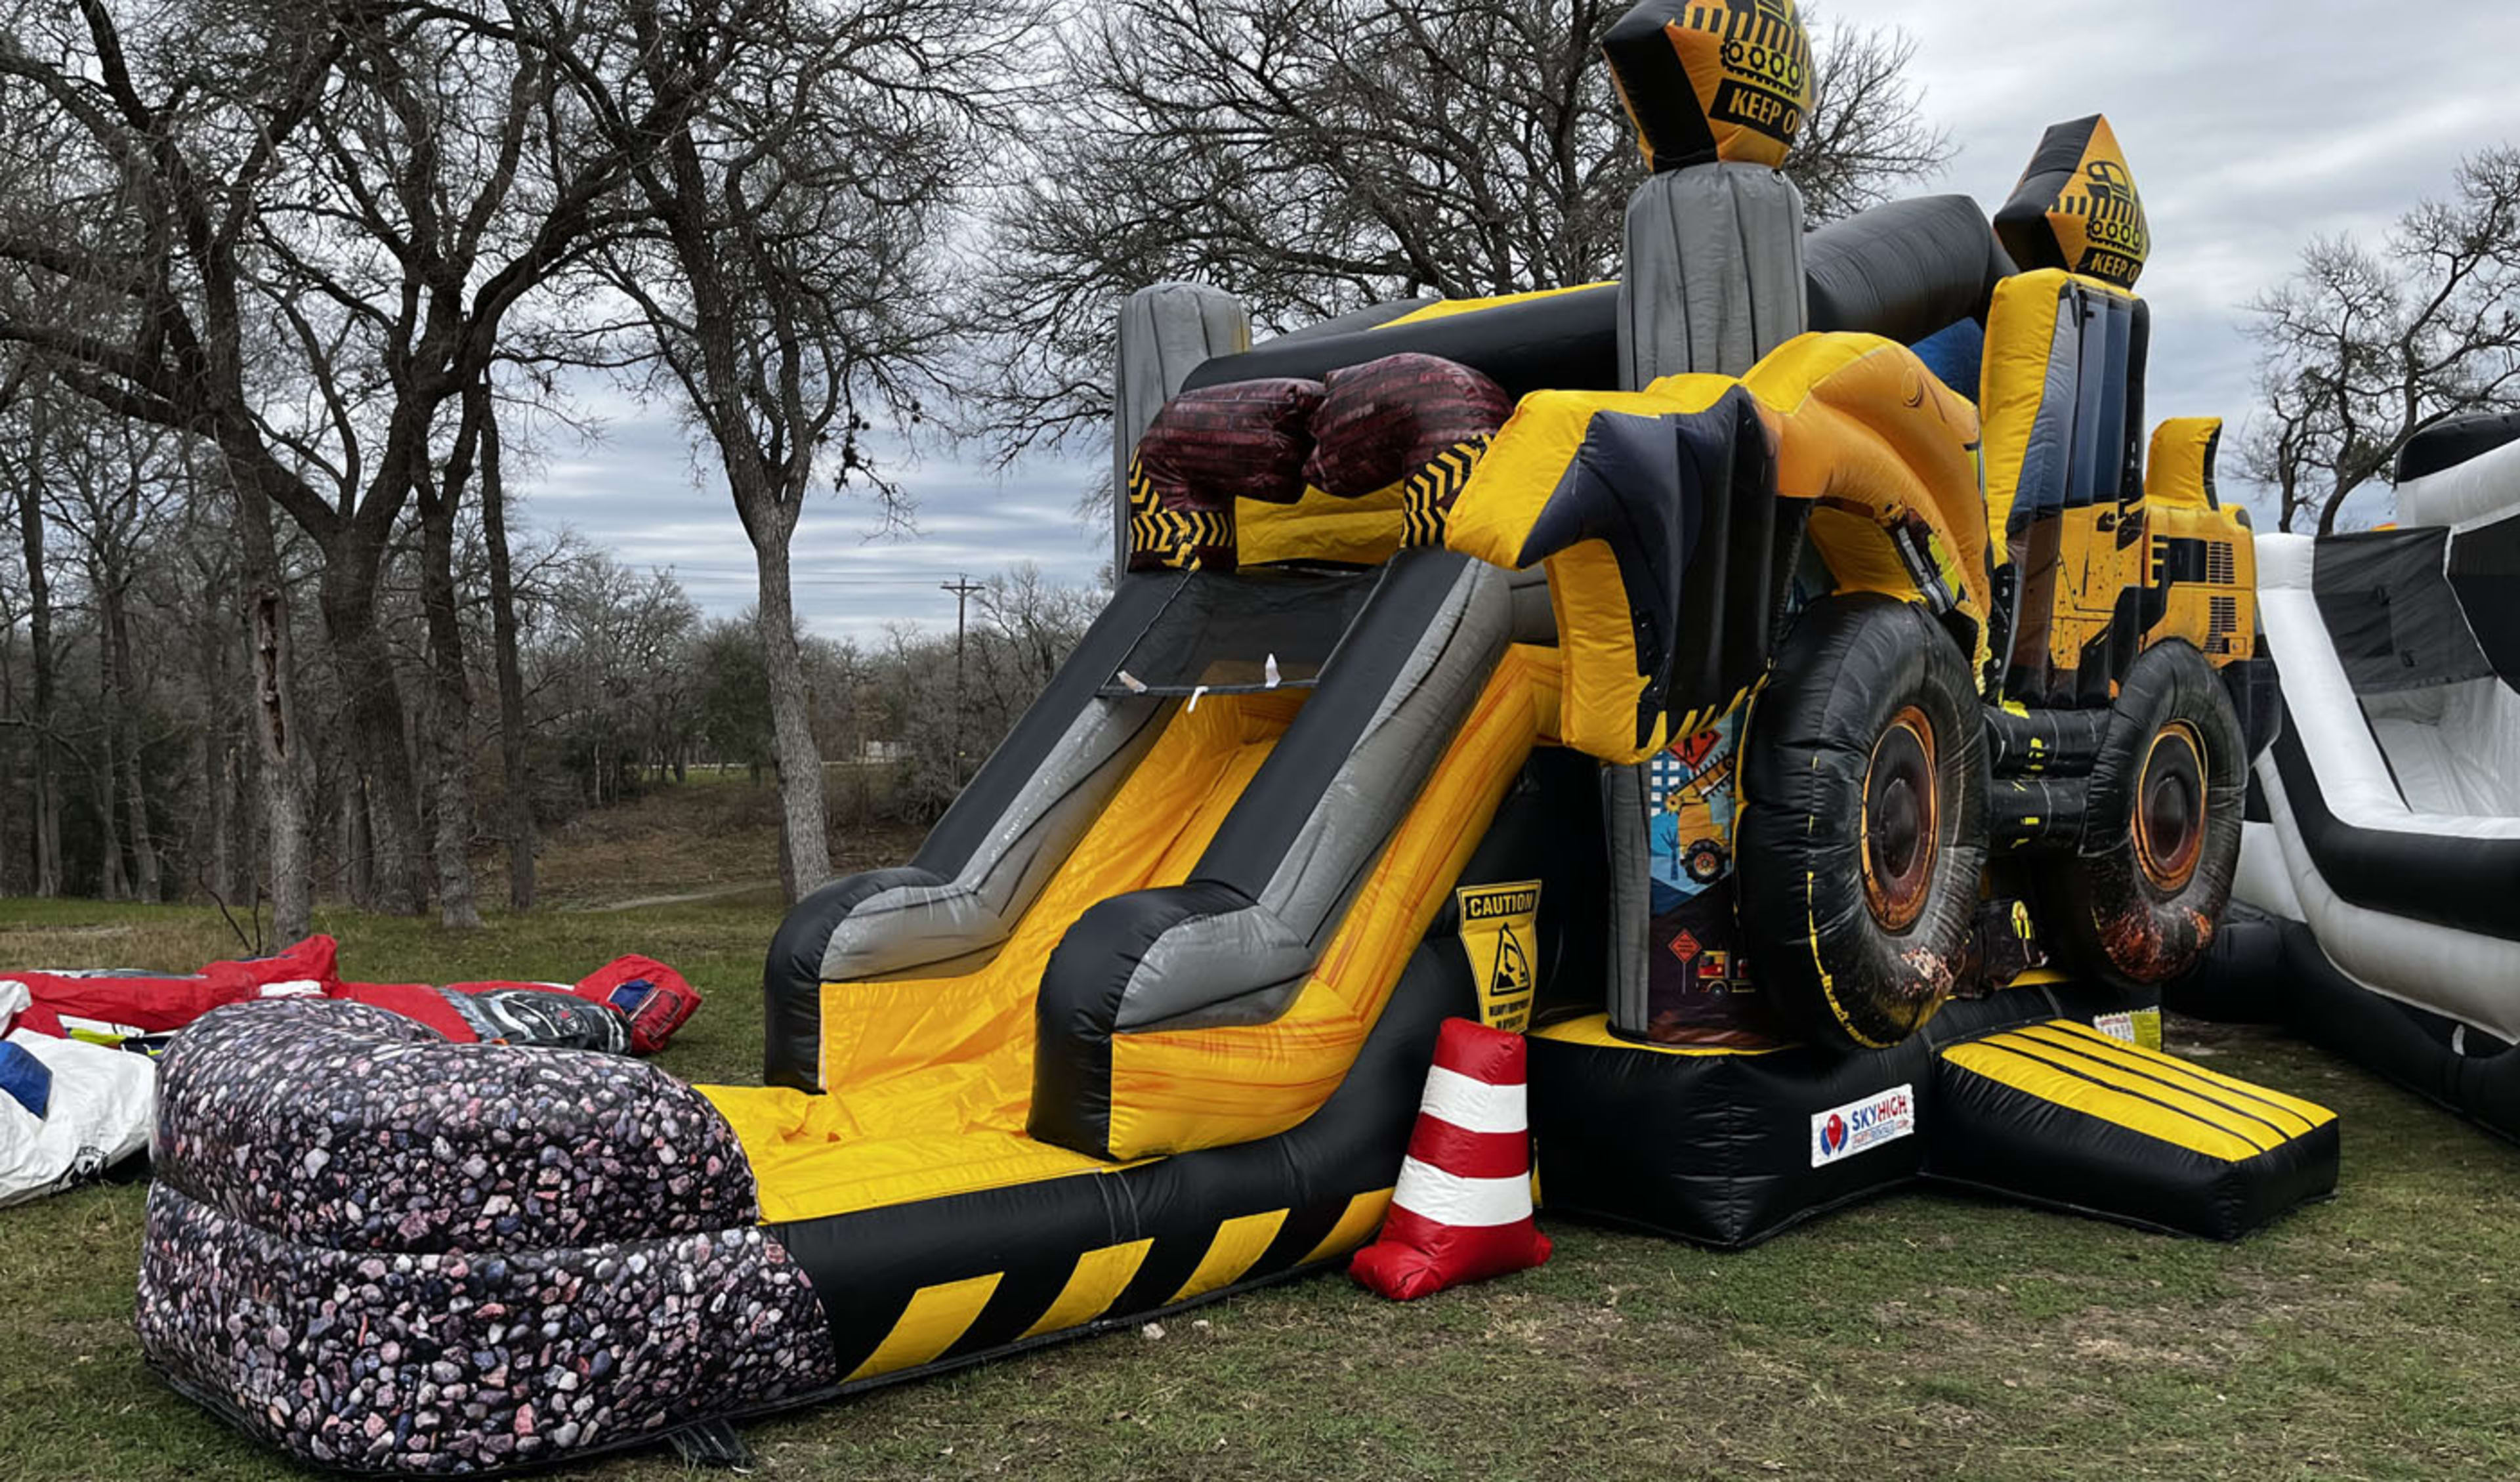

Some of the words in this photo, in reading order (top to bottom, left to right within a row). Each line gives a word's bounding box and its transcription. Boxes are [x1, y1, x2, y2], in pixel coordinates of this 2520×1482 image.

[1728, 87, 1781, 125] KEEP
[2090, 252, 2128, 278] KEEP
[1470, 893, 1534, 917] CAUTION
